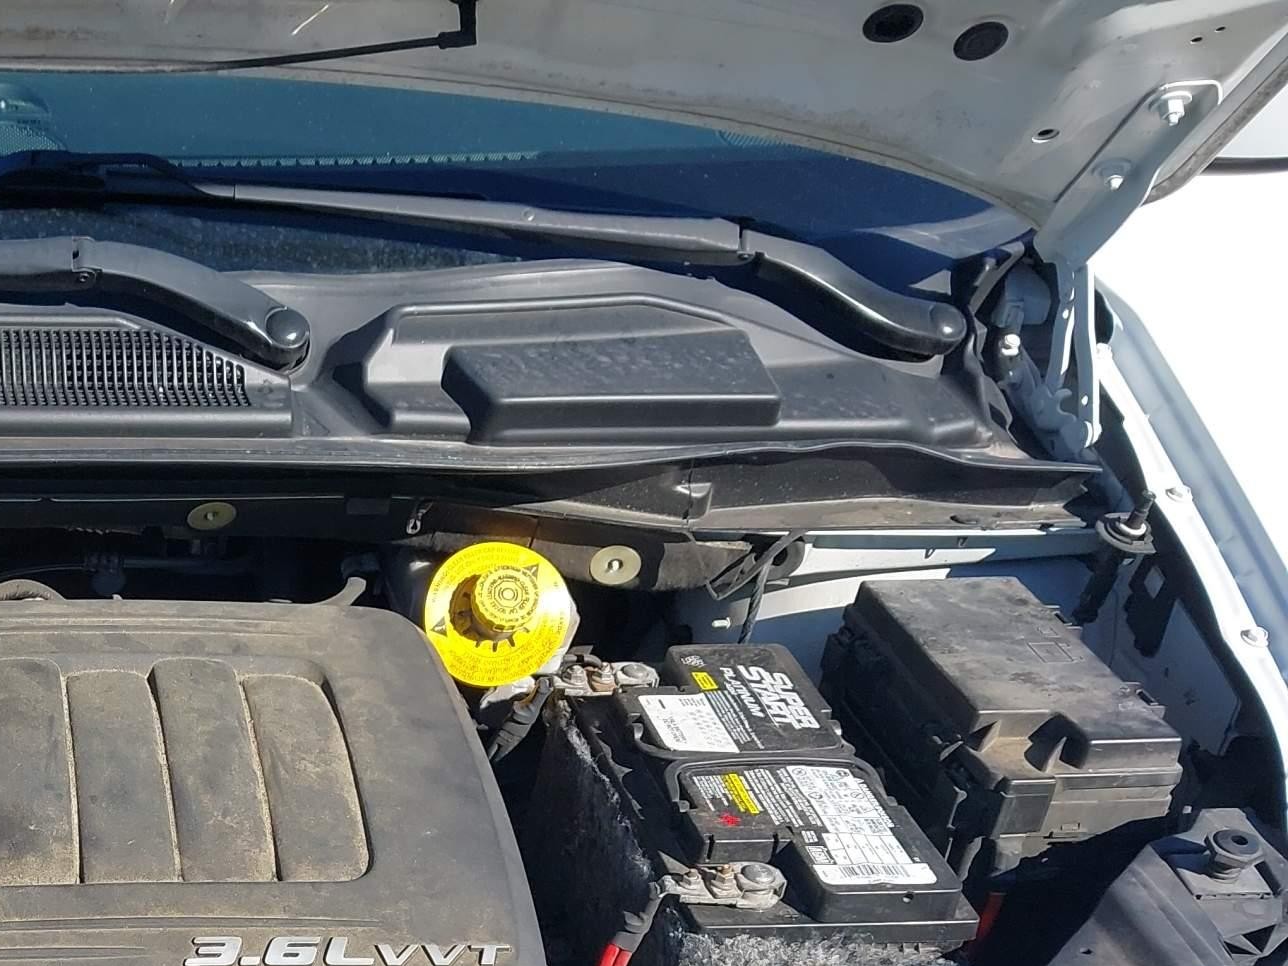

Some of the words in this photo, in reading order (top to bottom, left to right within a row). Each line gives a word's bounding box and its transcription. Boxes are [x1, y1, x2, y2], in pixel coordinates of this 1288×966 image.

[720, 667, 766, 718] PLATINUM
[737, 664, 802, 730] START
[767, 671, 821, 730] SUPER
